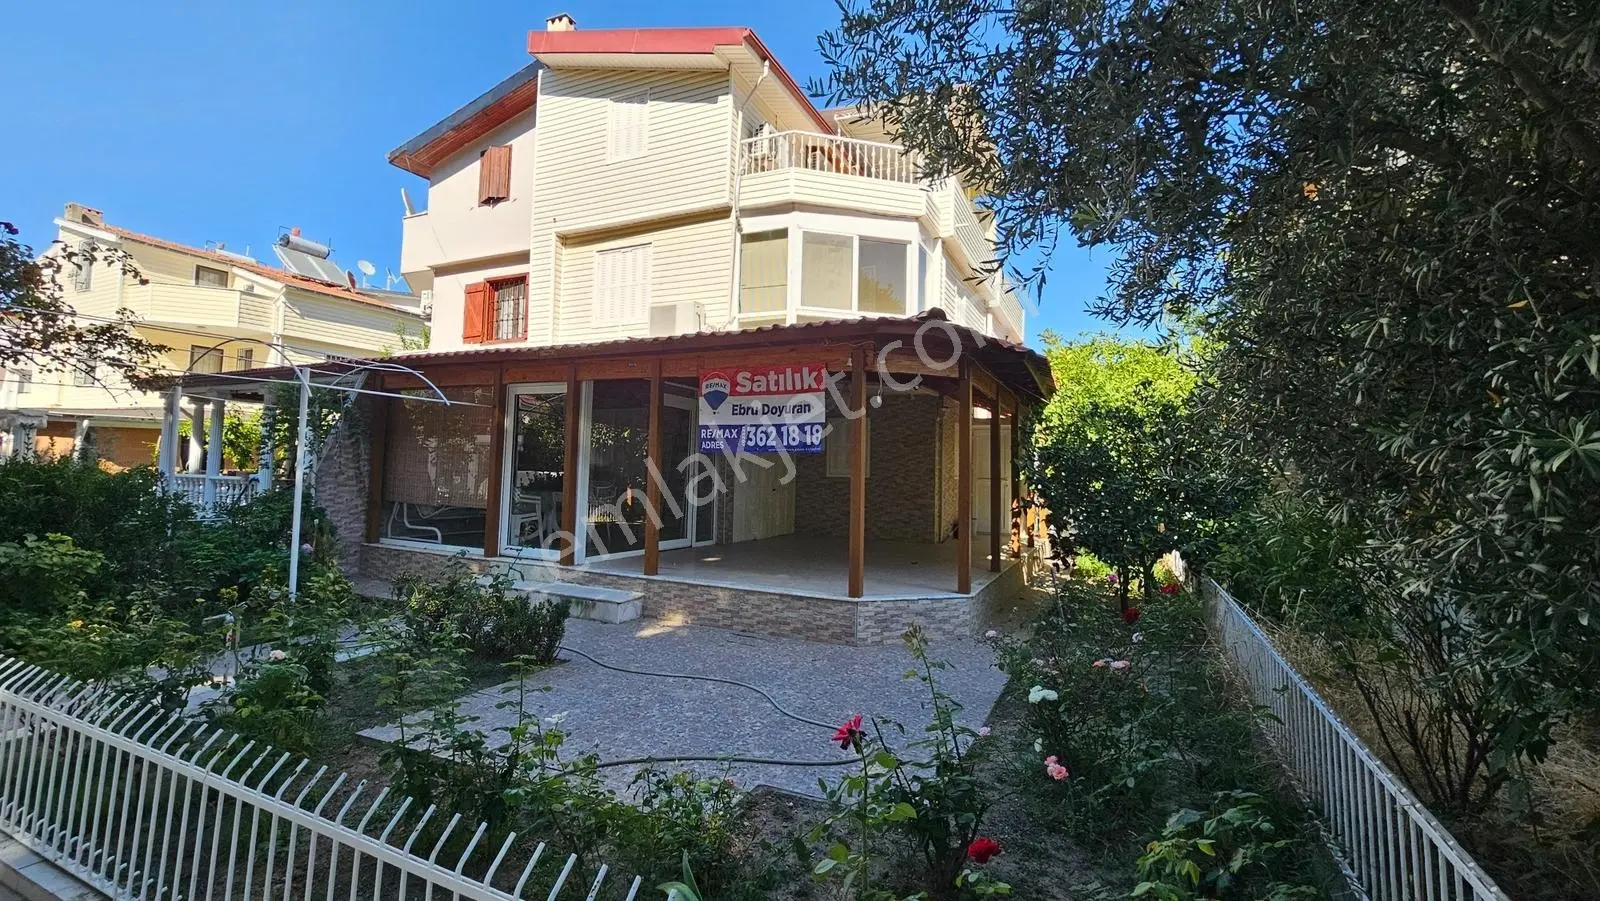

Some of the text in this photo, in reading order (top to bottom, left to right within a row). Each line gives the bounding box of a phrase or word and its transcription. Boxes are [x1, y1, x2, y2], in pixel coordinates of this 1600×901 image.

[704, 382, 728, 390] RE/MAX
[735, 367, 816, 393] Satılık
[731, 403, 811, 417] Ebru Doyuran
[701, 429, 738, 439] RE/MAX
[746, 426, 776, 447] 362
[780, 425, 800, 447] 18
[701, 441, 725, 449] ADRES
